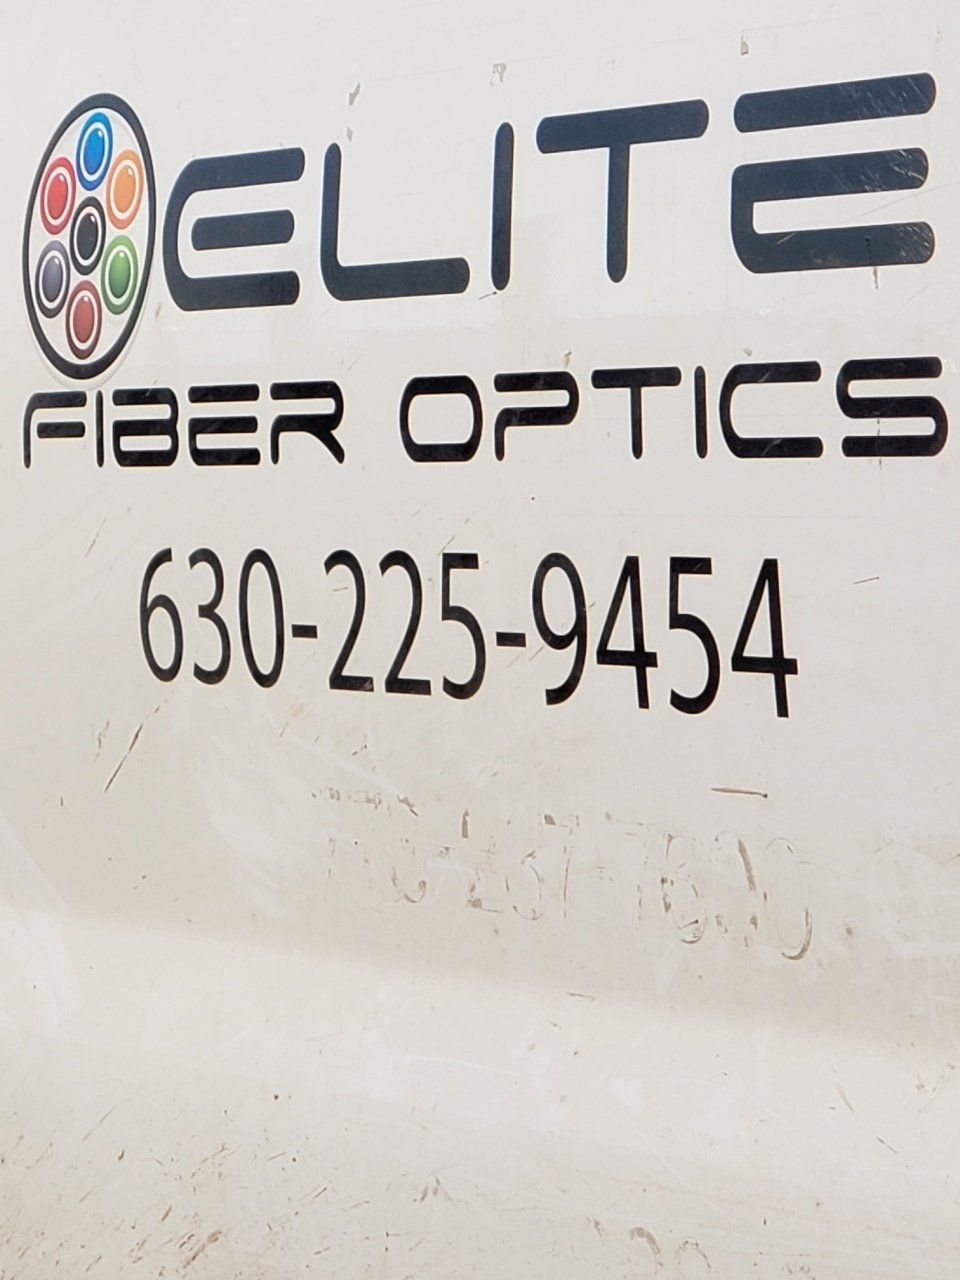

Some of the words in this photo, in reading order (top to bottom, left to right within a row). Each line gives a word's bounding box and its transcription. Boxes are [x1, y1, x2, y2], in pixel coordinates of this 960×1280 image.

[162, 72, 937, 312] ELITE
[23, 380, 345, 469] FIBER
[399, 356, 949, 463] OPTICS
[139, 547, 799, 719] 630-225-9454
